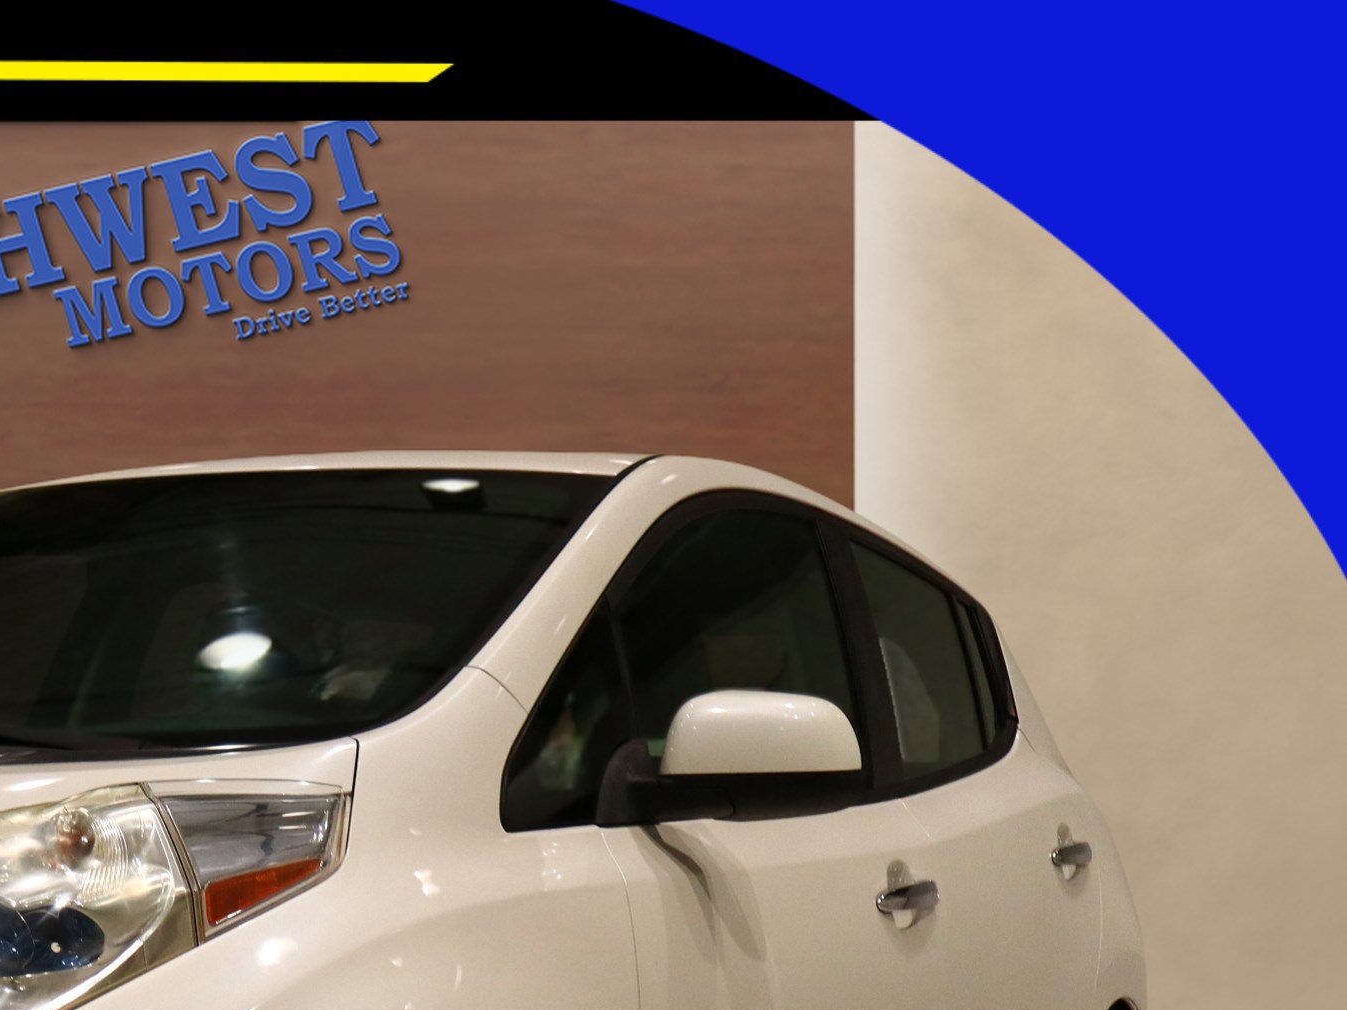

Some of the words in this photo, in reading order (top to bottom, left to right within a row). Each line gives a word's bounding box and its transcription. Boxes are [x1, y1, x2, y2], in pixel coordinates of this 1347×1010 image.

[54, 215, 402, 347] MOTORS
[234, 308, 311, 340] Drive
[320, 283, 410, 319] Better
